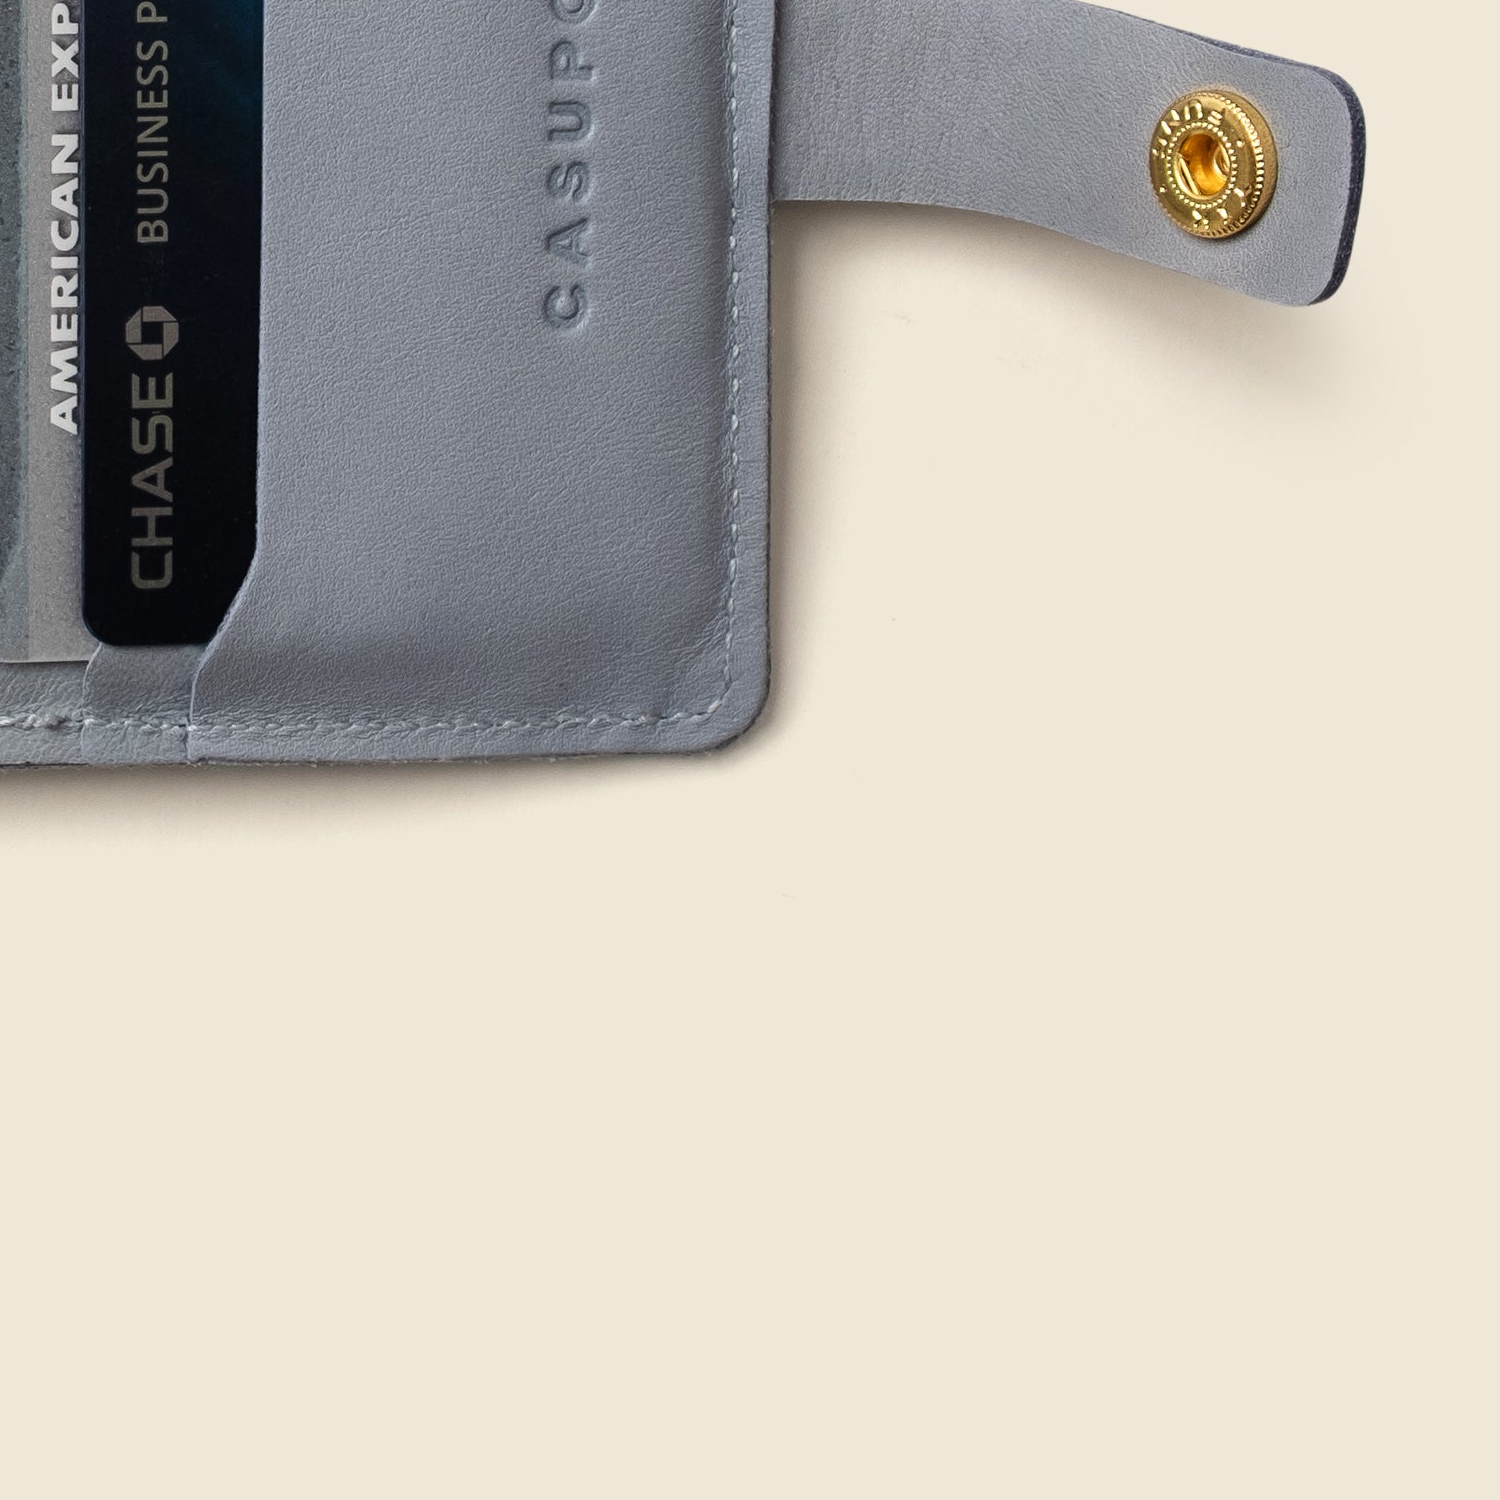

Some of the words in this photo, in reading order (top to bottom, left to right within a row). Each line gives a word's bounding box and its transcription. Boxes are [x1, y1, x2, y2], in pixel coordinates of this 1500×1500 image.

[135, 40, 171, 245] BUSINESS
[49, 132, 80, 435] AMERICAN
[130, 370, 177, 590] CHASE
